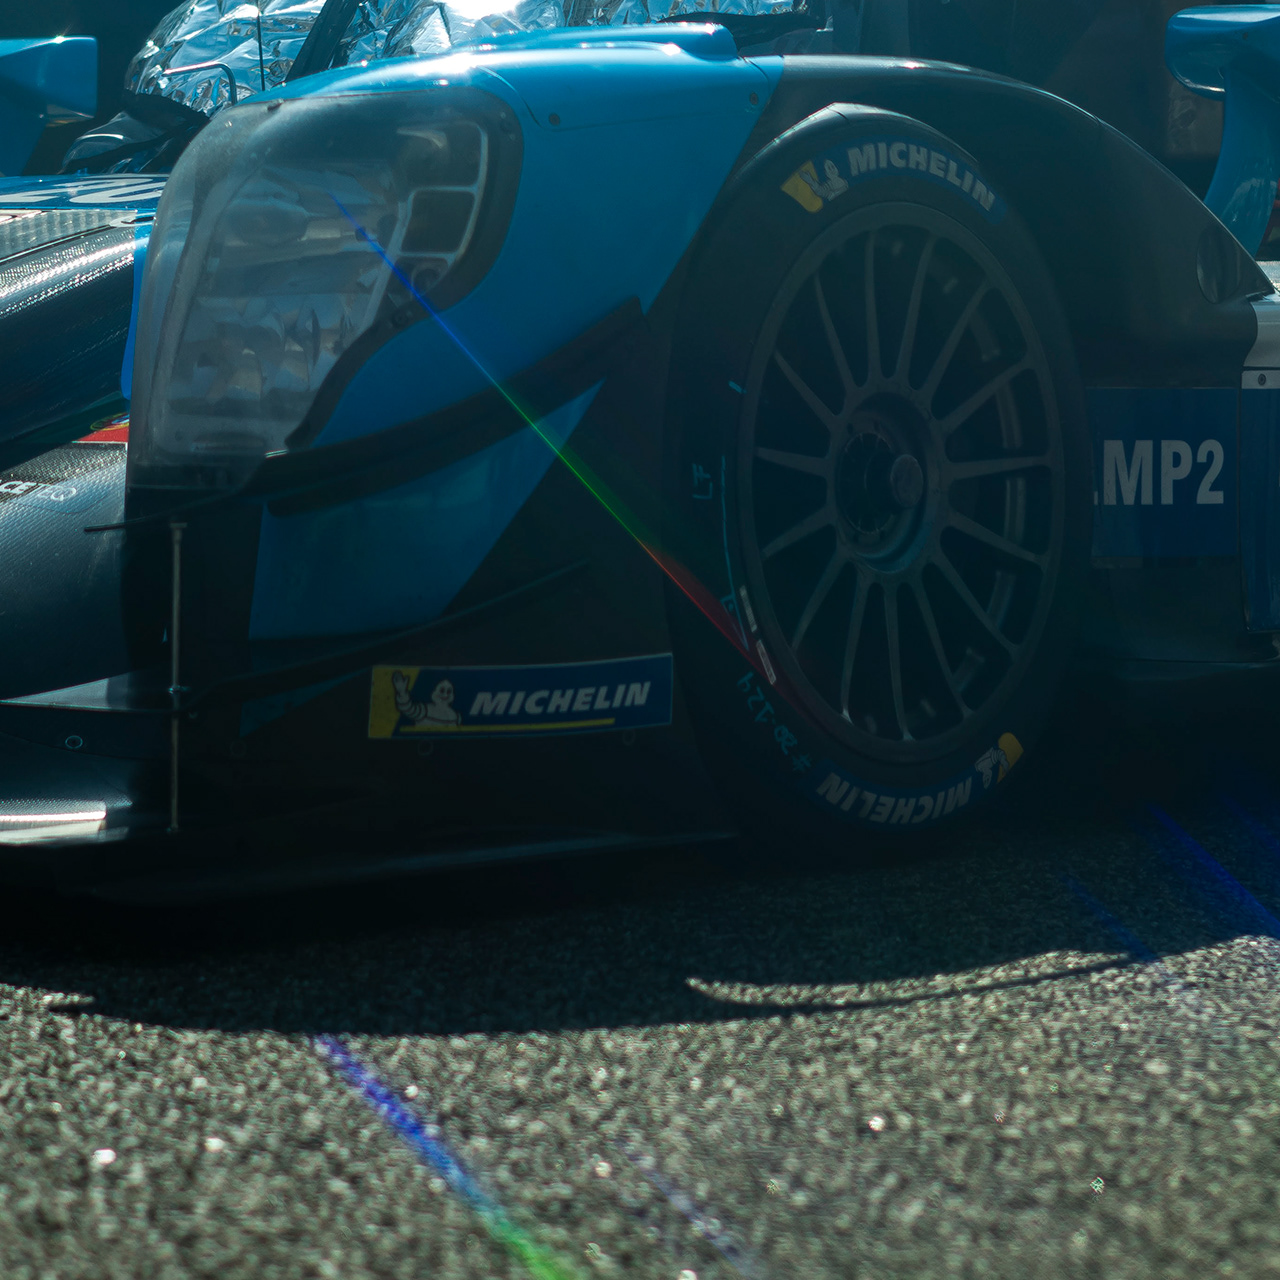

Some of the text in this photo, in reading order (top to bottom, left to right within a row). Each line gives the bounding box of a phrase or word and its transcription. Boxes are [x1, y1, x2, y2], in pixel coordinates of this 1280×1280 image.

[846, 141, 997, 213] MICHELIN
[1092, 439, 1225, 506] MP2
[469, 680, 652, 717] MICHELIN
[815, 771, 973, 825] MICHELIN
